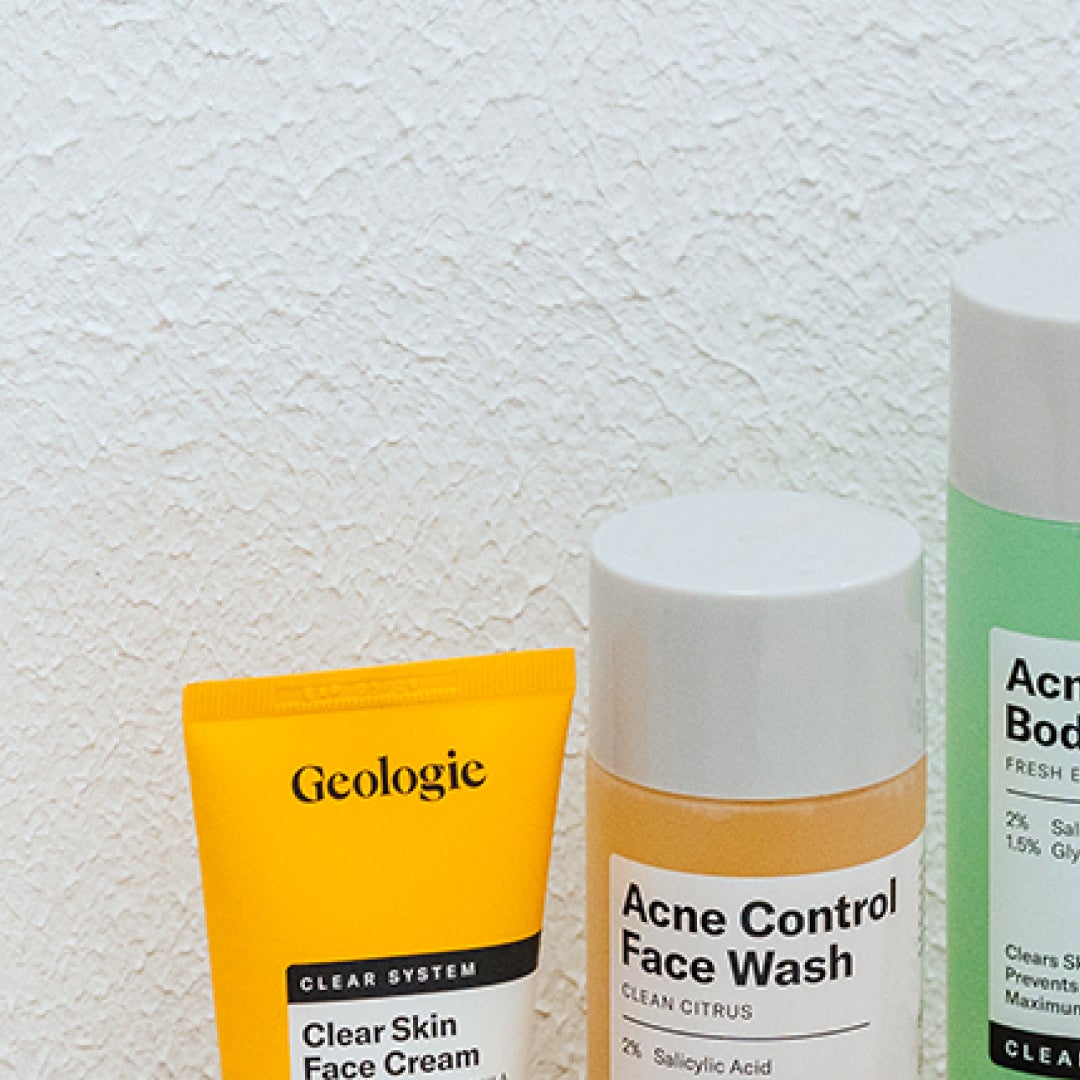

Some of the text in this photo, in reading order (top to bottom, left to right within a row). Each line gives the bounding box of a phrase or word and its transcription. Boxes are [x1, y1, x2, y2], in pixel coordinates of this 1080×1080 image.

[291, 749, 487, 803] Geologie
[1005, 755, 1063, 781] FRESH
[1005, 810, 1029, 831] 2%
[1005, 833, 1042, 857] 1.5%
[622, 876, 897, 938] Acne Control
[622, 928, 855, 987] Face Wash
[1004, 944, 1060, 969] Clears
[300, 961, 476, 991] CLEAR SYSTEM
[1004, 966, 1080, 994] Prevents
[621, 982, 753, 1021] CLEAN CITRUS
[302, 1012, 457, 1049] Clear Skin
[303, 1045, 480, 1080] Face Cream
[621, 1036, 772, 1076] 2% Salicylic Acid
